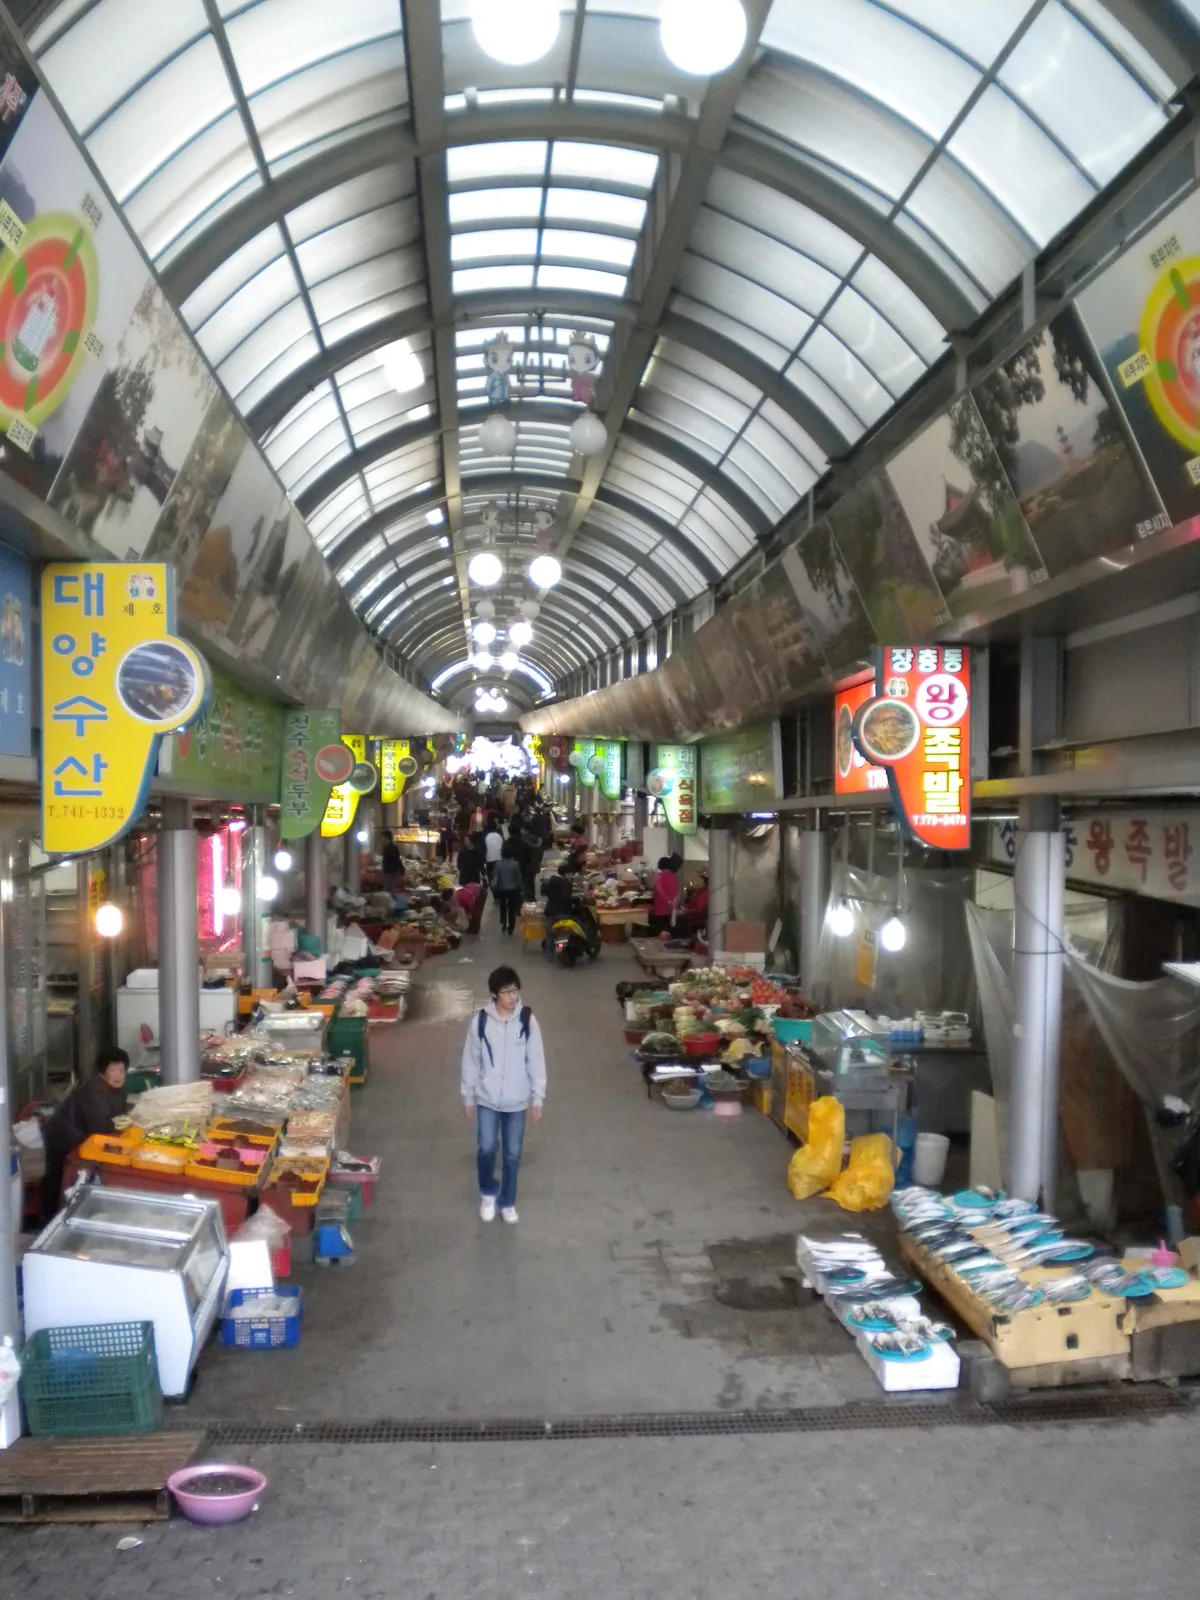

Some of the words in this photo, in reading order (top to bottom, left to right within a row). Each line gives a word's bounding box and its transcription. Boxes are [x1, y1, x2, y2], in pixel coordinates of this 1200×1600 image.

[1122, 352, 1151, 380] 서부지역
[150, 602, 164, 615] 호
[891, 648, 964, 673] 장충동
[52, 571, 109, 797] 대양수산
[46, 804, 125, 819] T.741-1332
[1086, 818, 1194, 892] 왕족발
